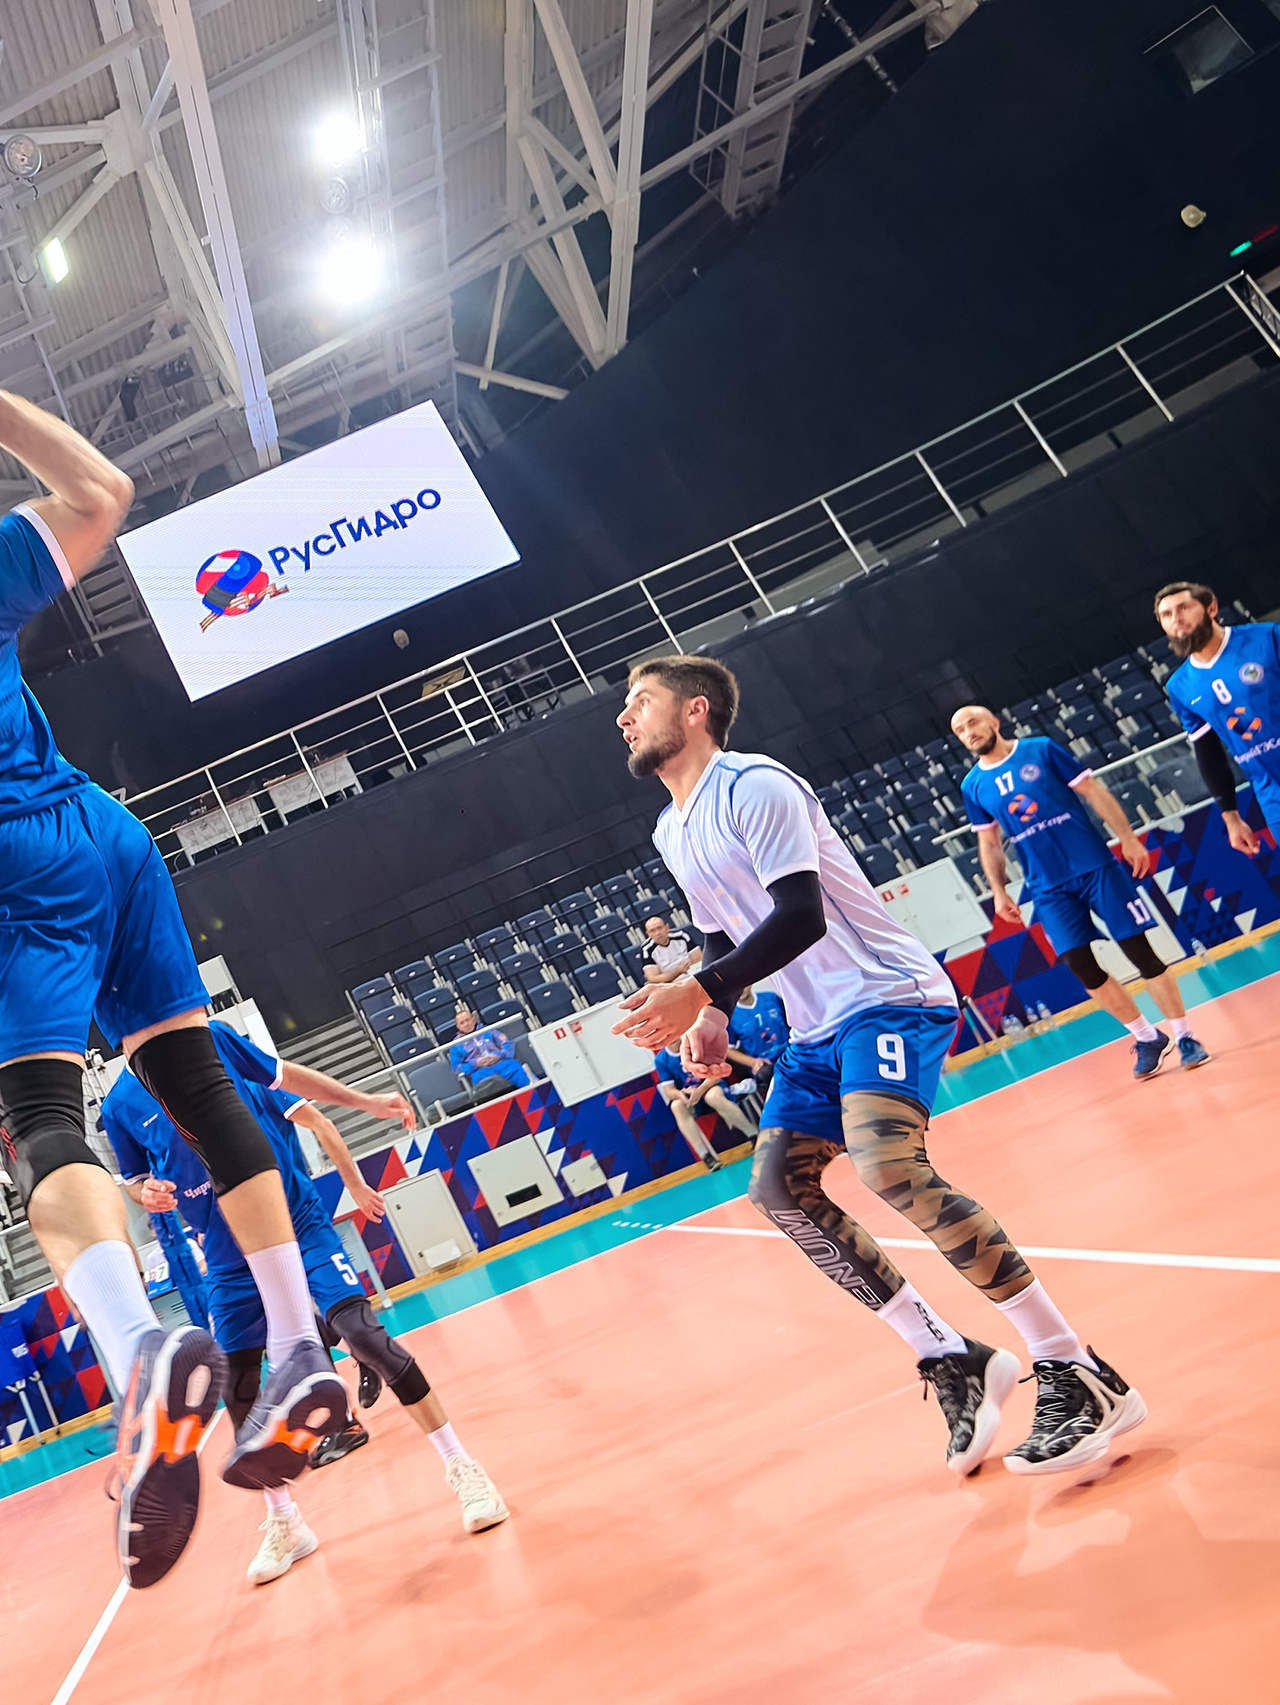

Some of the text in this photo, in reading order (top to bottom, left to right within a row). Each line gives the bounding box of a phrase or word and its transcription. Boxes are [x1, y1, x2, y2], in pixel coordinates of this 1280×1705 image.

[267, 488, 442, 576] РусГидро
[1211, 678, 1232, 704] 8
[994, 770, 1015, 796] 17
[876, 1033, 907, 1082] 9
[330, 1252, 359, 1286] 5
[769, 1208, 885, 1312] ENUM
